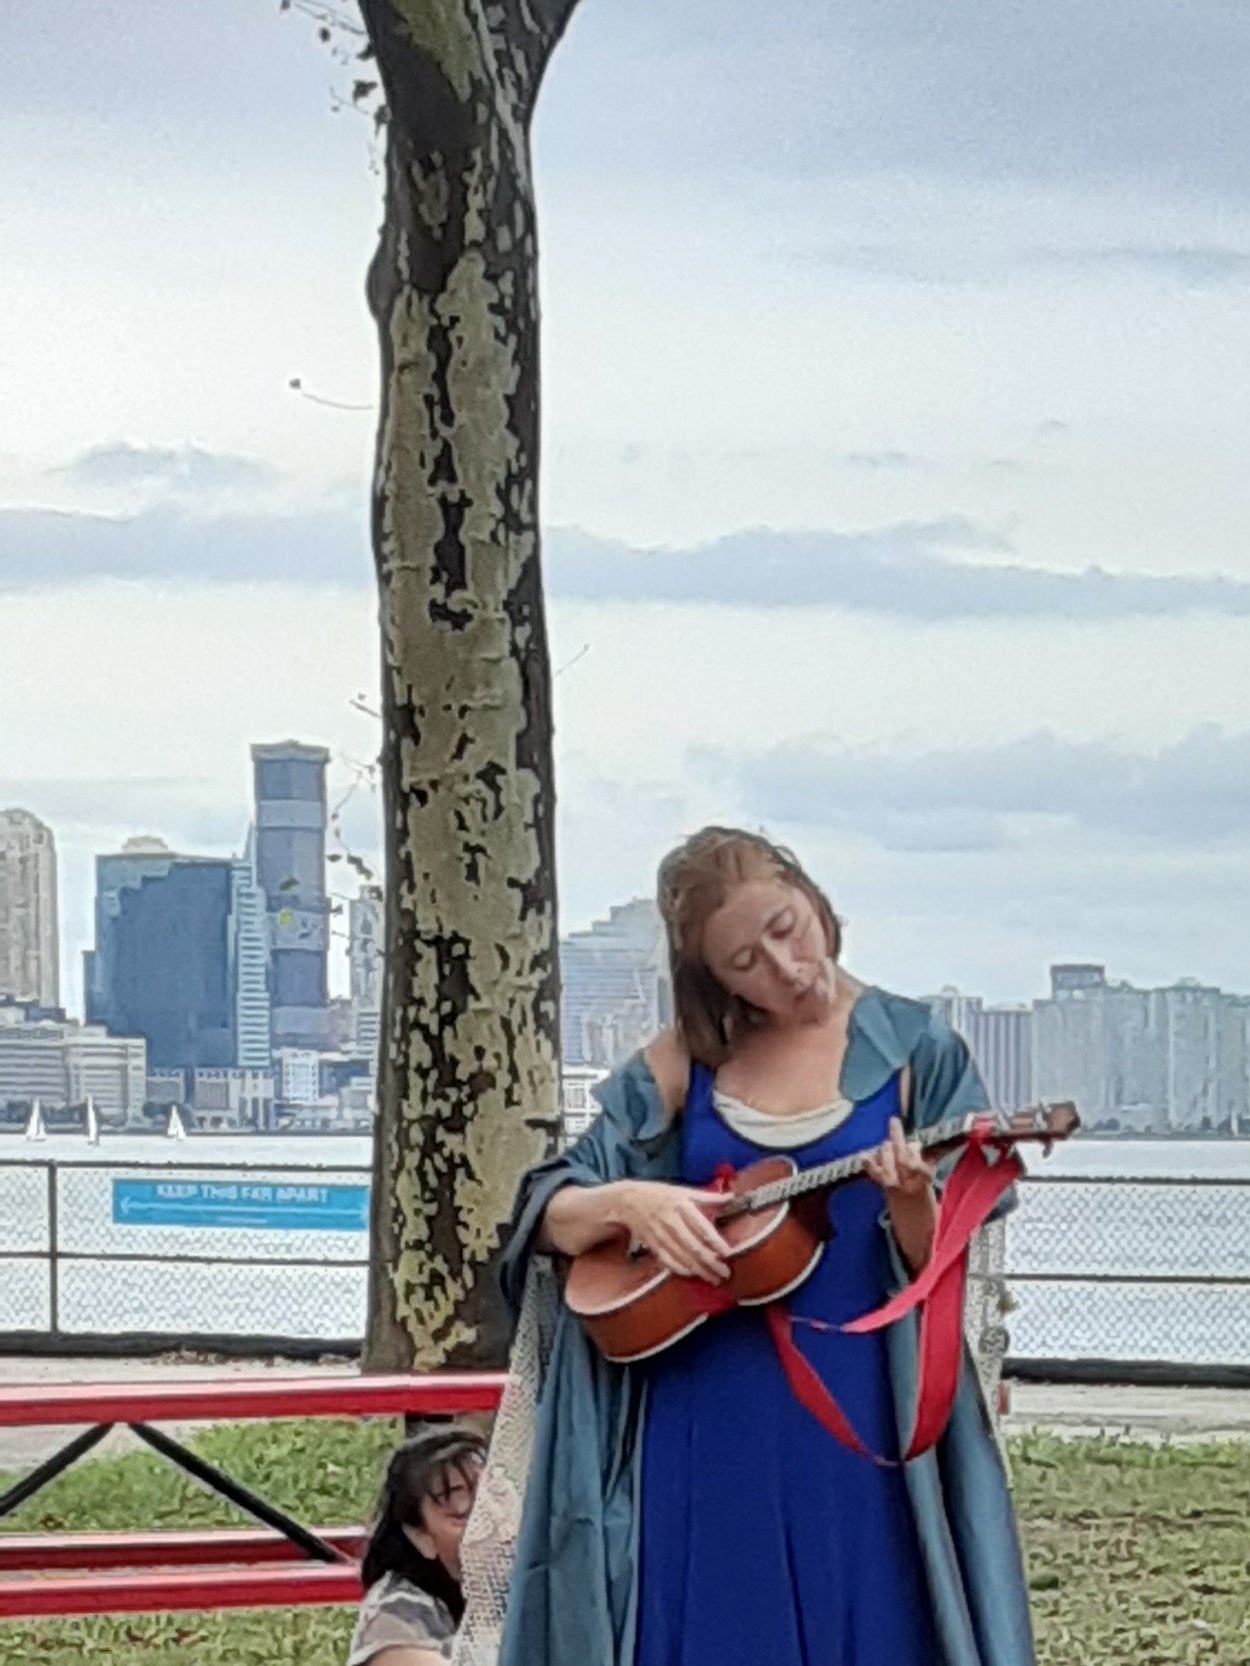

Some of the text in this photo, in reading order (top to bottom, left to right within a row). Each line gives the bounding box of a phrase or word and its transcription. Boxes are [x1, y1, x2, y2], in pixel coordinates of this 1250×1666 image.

[156, 1184, 328, 1204] KEEP THIS FAR APART
